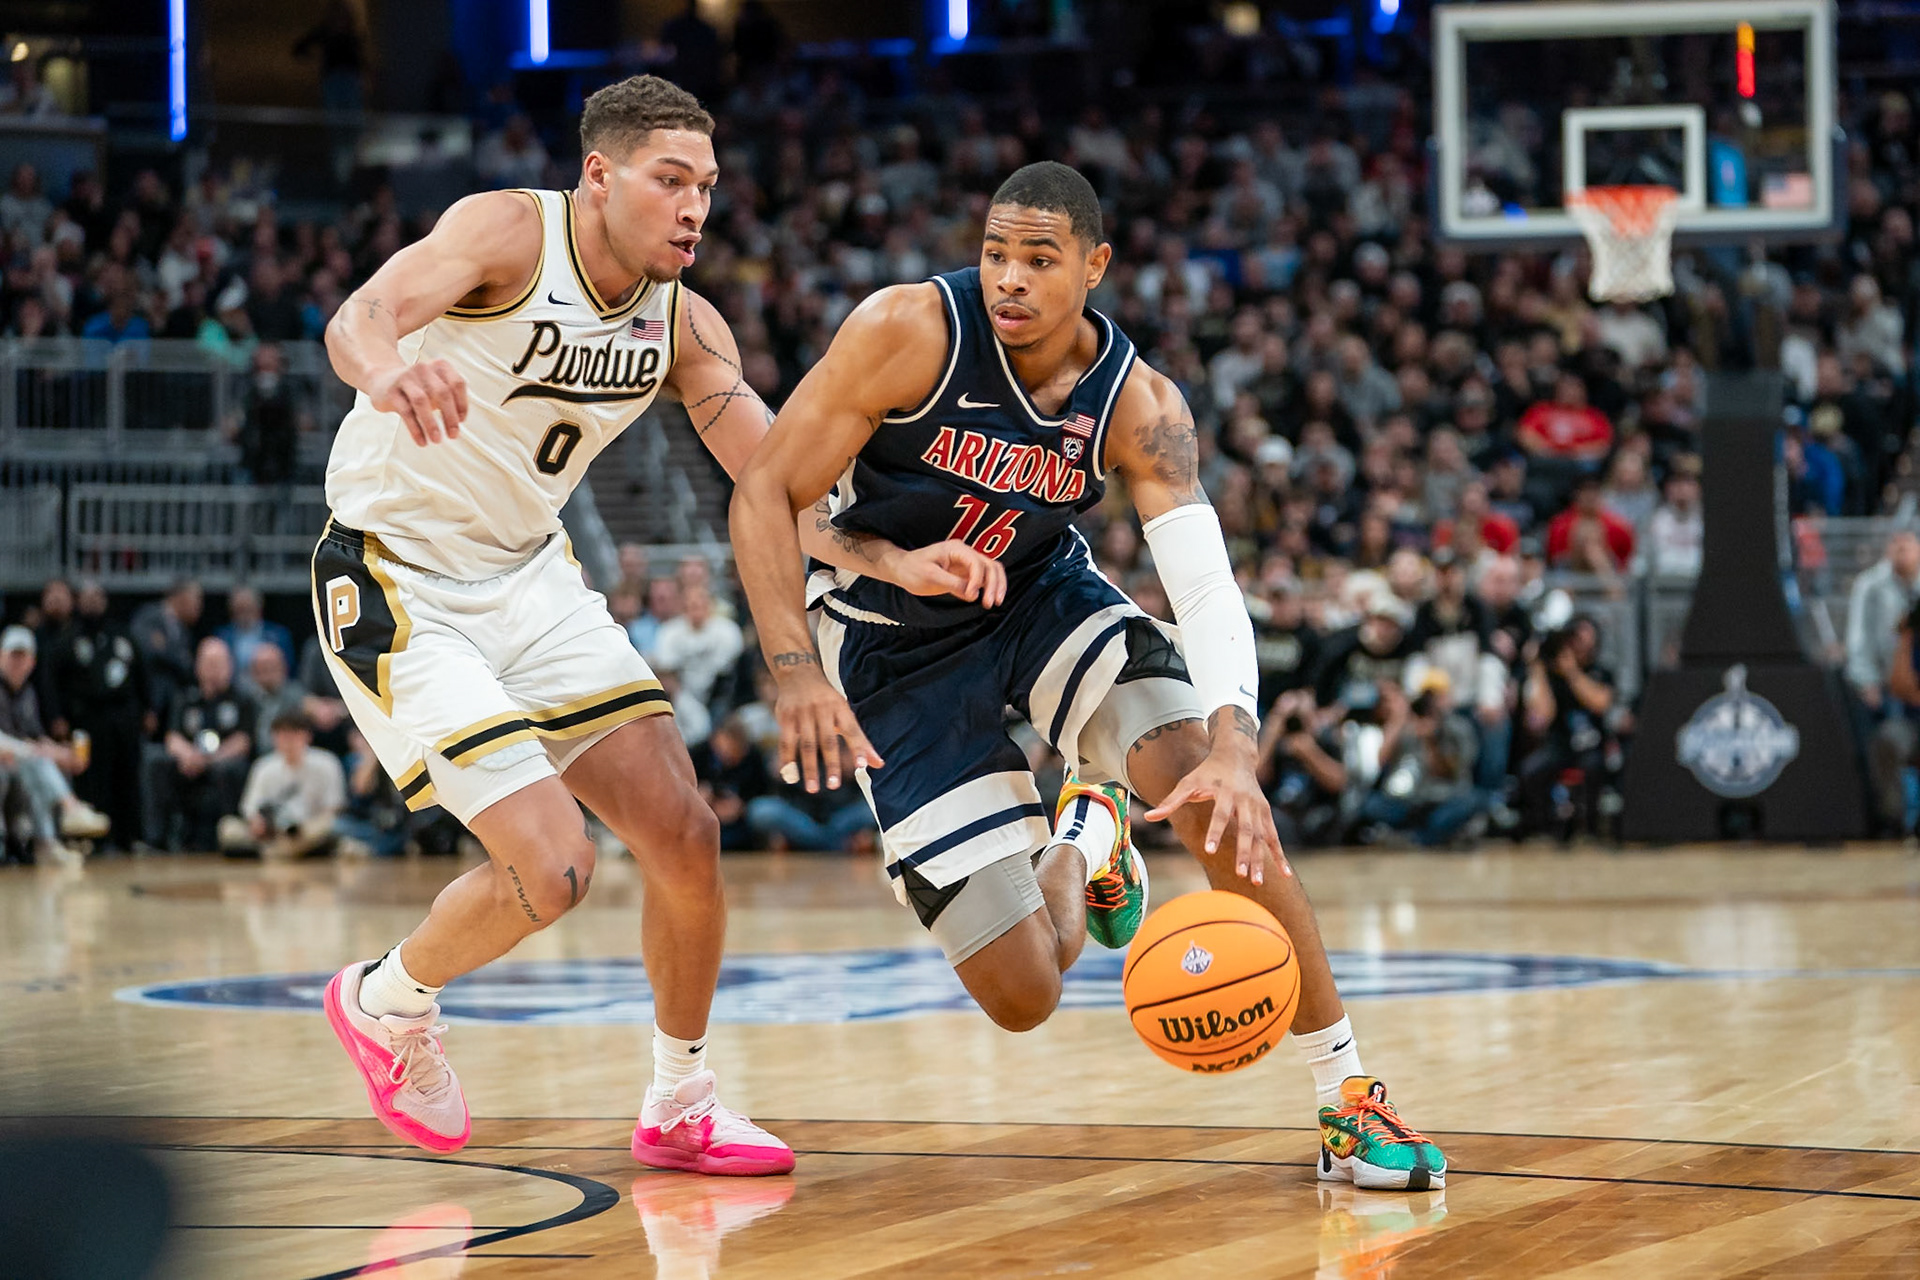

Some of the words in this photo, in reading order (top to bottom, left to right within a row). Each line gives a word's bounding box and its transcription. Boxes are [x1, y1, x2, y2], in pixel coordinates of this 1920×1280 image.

[511, 321, 660, 390] Purdue
[533, 419, 582, 476] 0
[921, 426, 1086, 503] ARIZONA
[1066, 448, 1079, 460] 12
[949, 494, 1025, 562] 16
[325, 574, 361, 654] P
[1158, 996, 1275, 1043] Wilson
